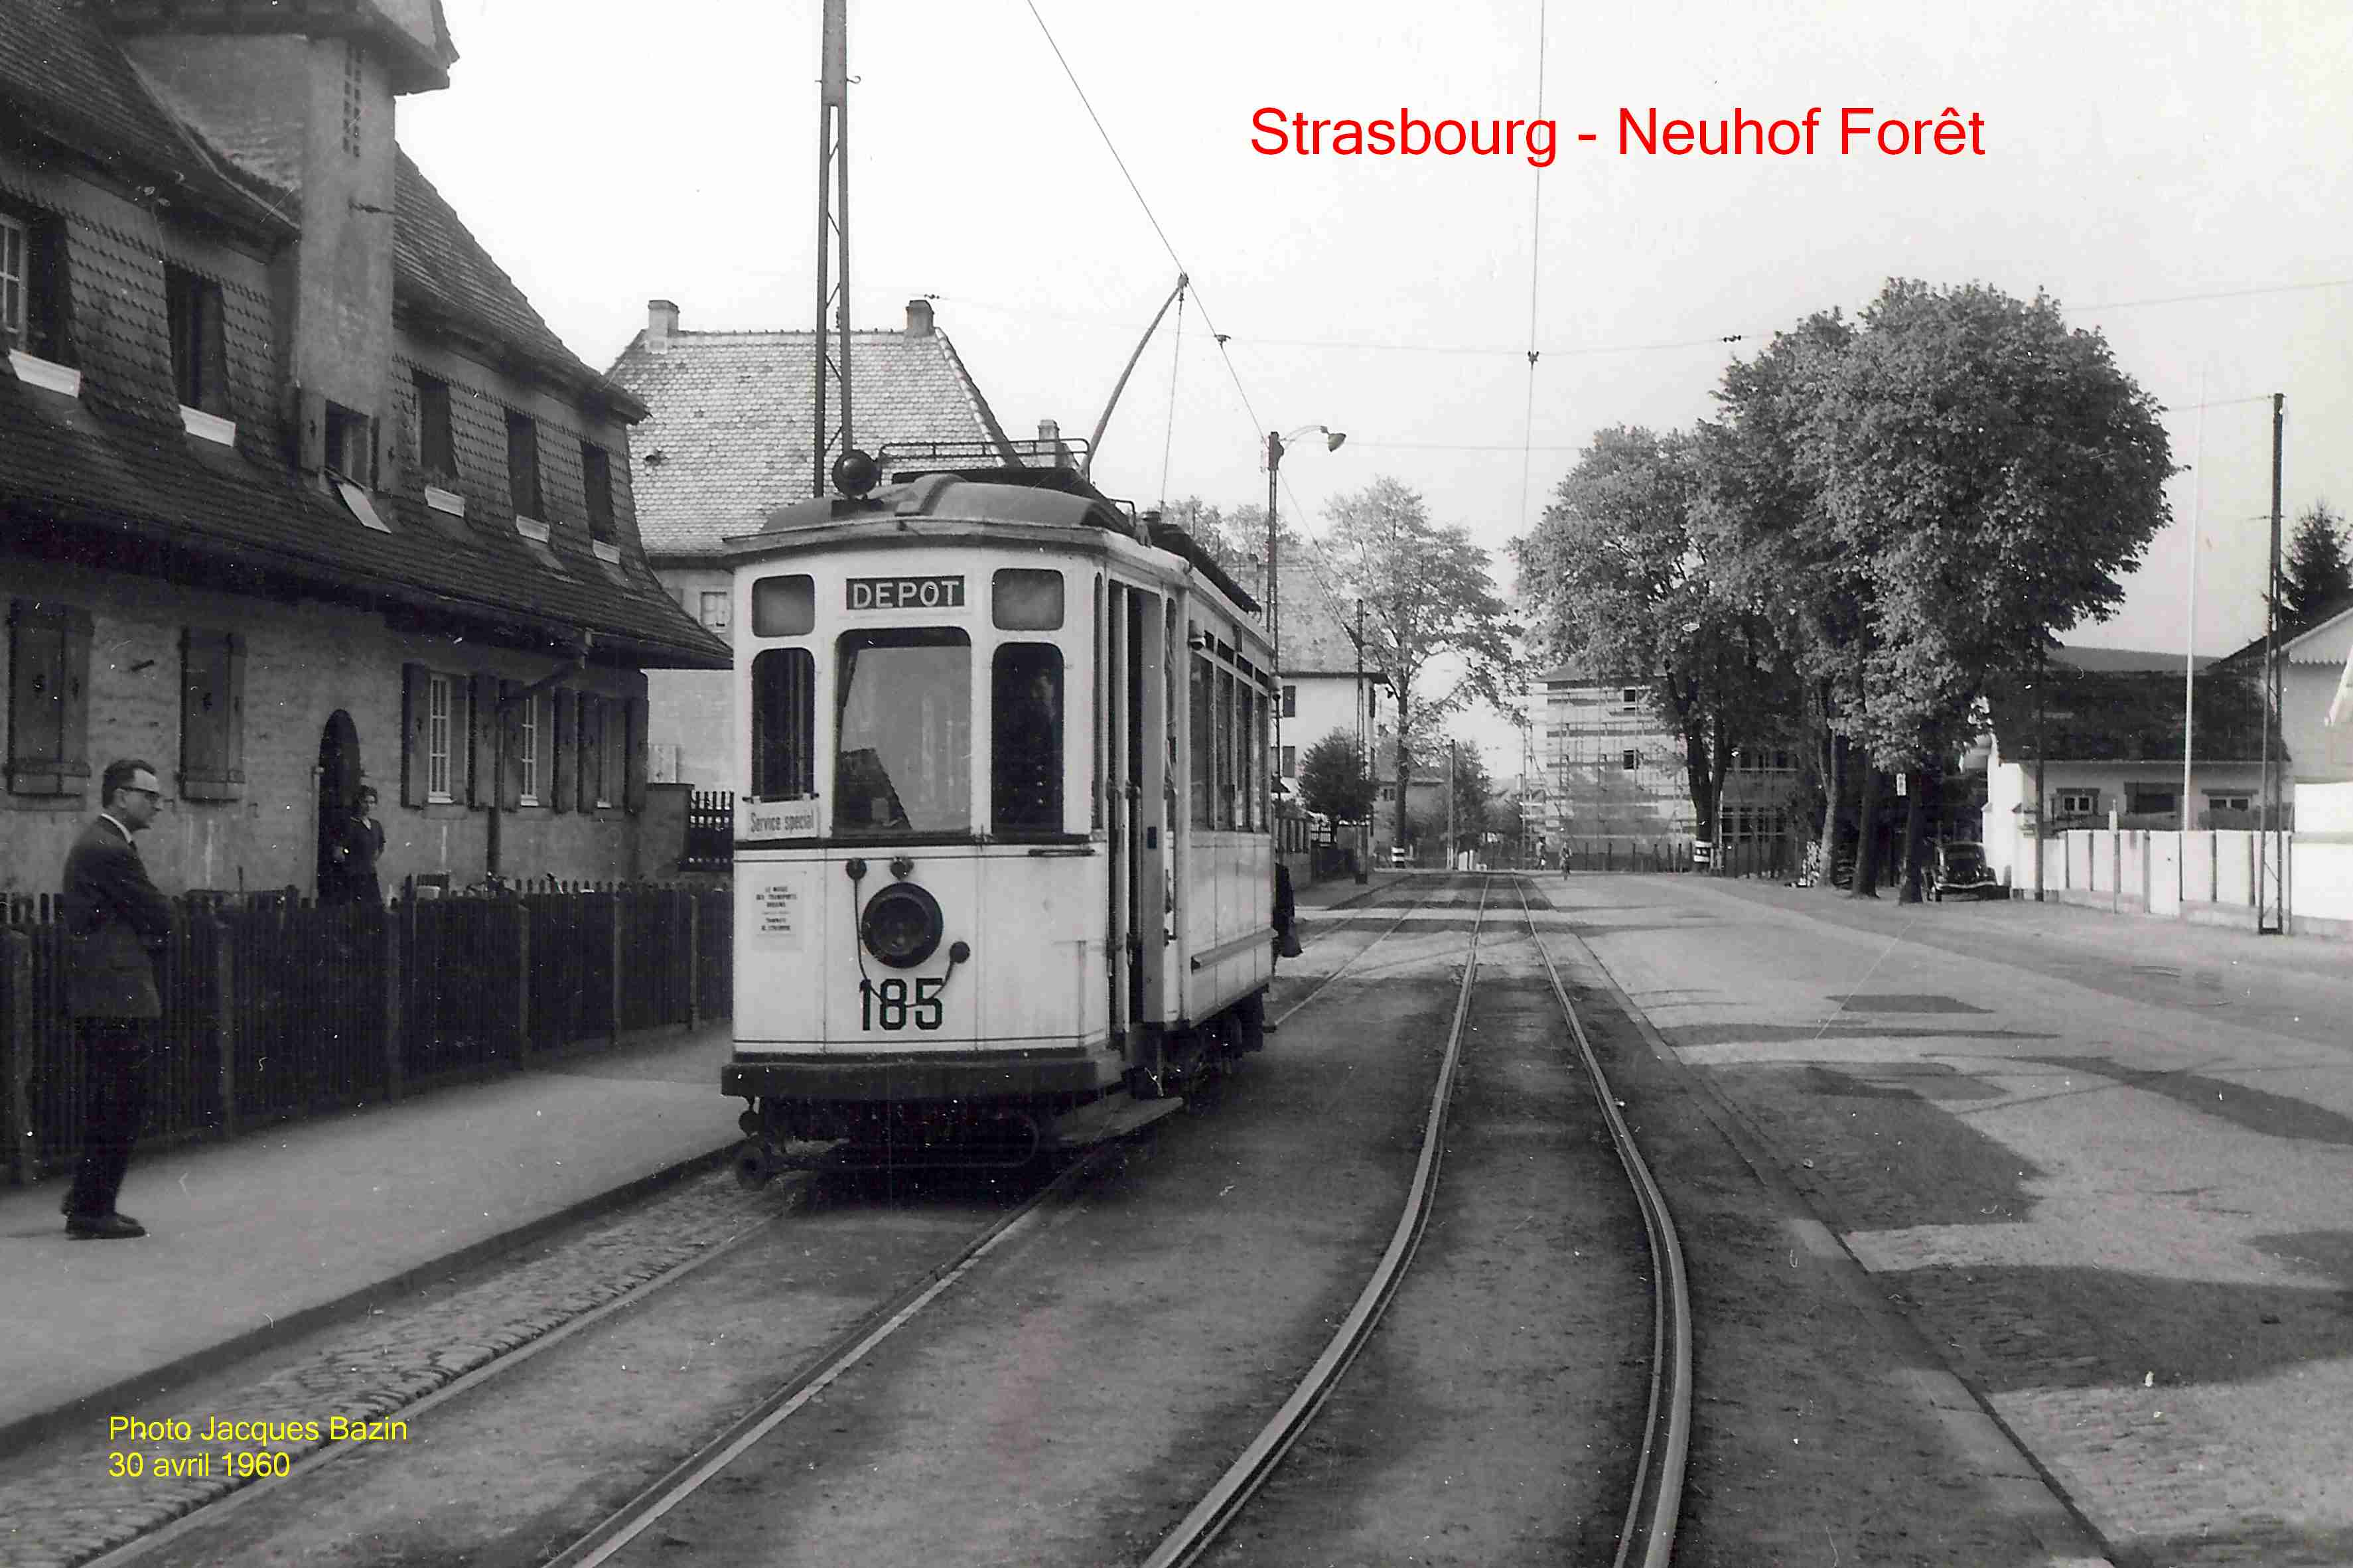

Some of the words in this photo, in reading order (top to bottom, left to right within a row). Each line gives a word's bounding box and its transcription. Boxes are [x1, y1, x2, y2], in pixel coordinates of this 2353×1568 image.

[853, 581, 960, 608] DEPOT
[750, 812, 781, 832] Service
[859, 977, 943, 1031] 185
